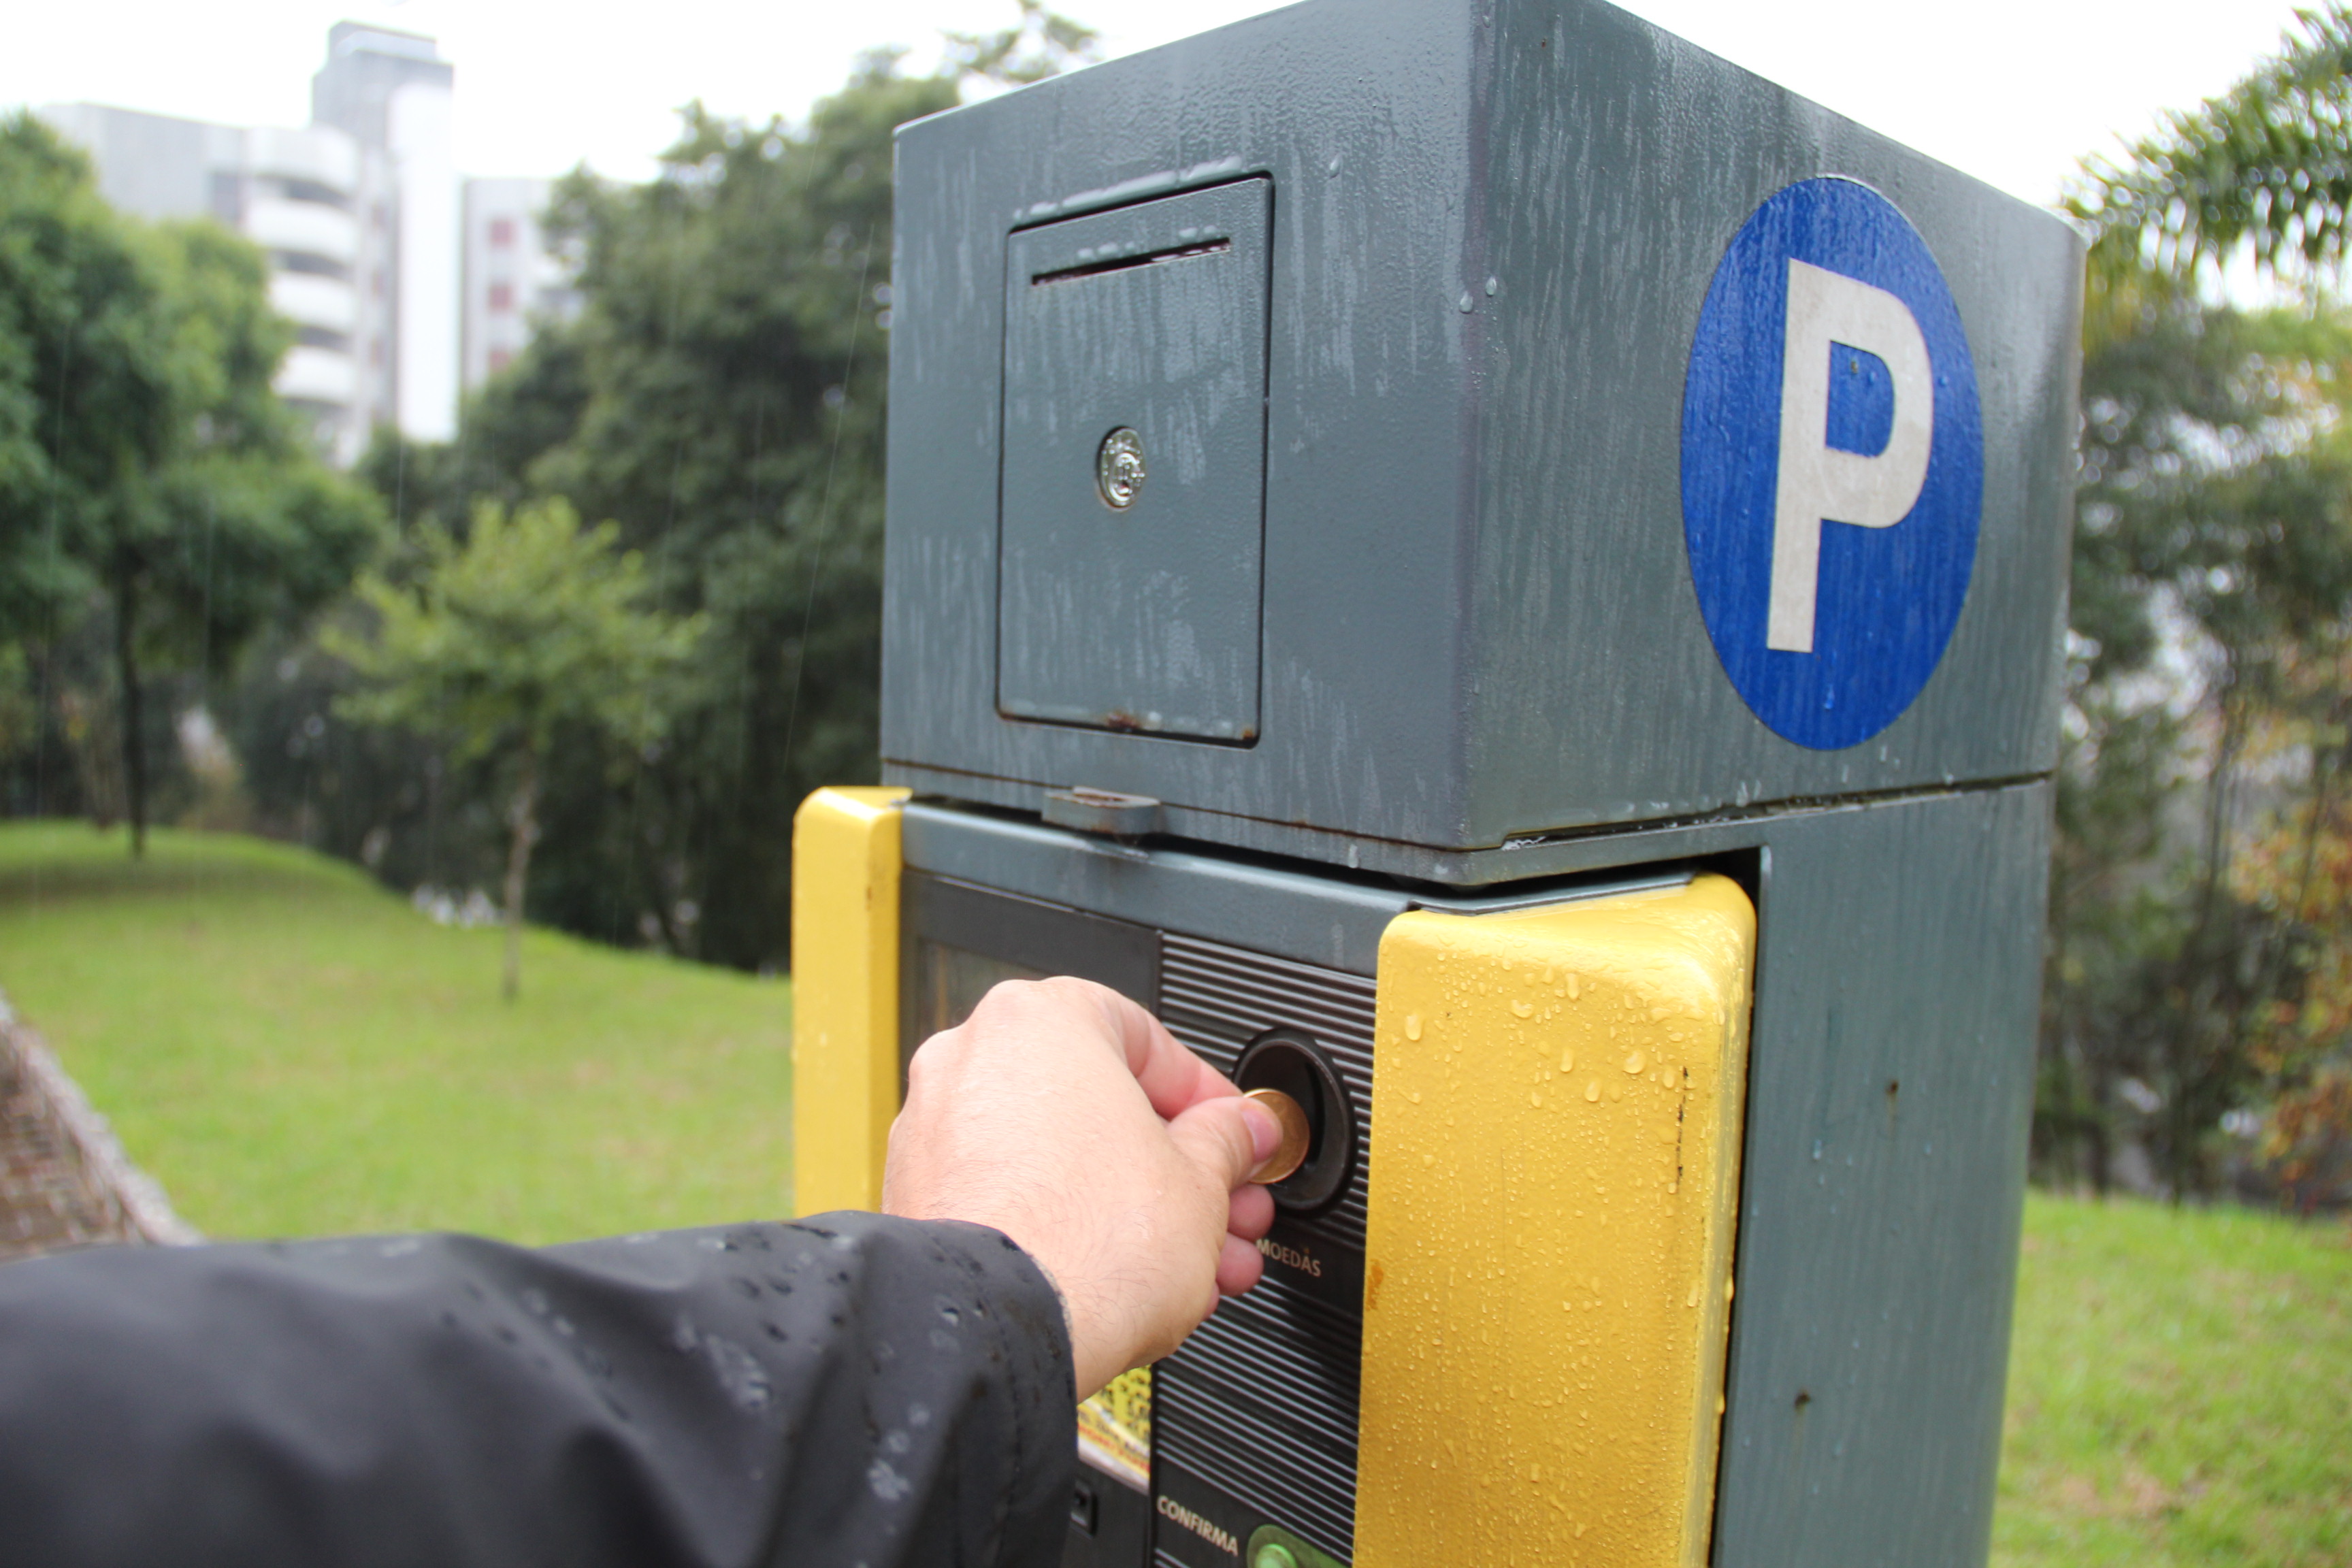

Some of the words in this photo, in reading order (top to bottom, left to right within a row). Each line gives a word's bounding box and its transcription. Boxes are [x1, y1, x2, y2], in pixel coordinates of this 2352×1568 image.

[1767, 257, 1933, 653] P
[1256, 1239, 1322, 1277] MOEDAS
[1157, 1495, 1238, 1557] CONFIRMA
